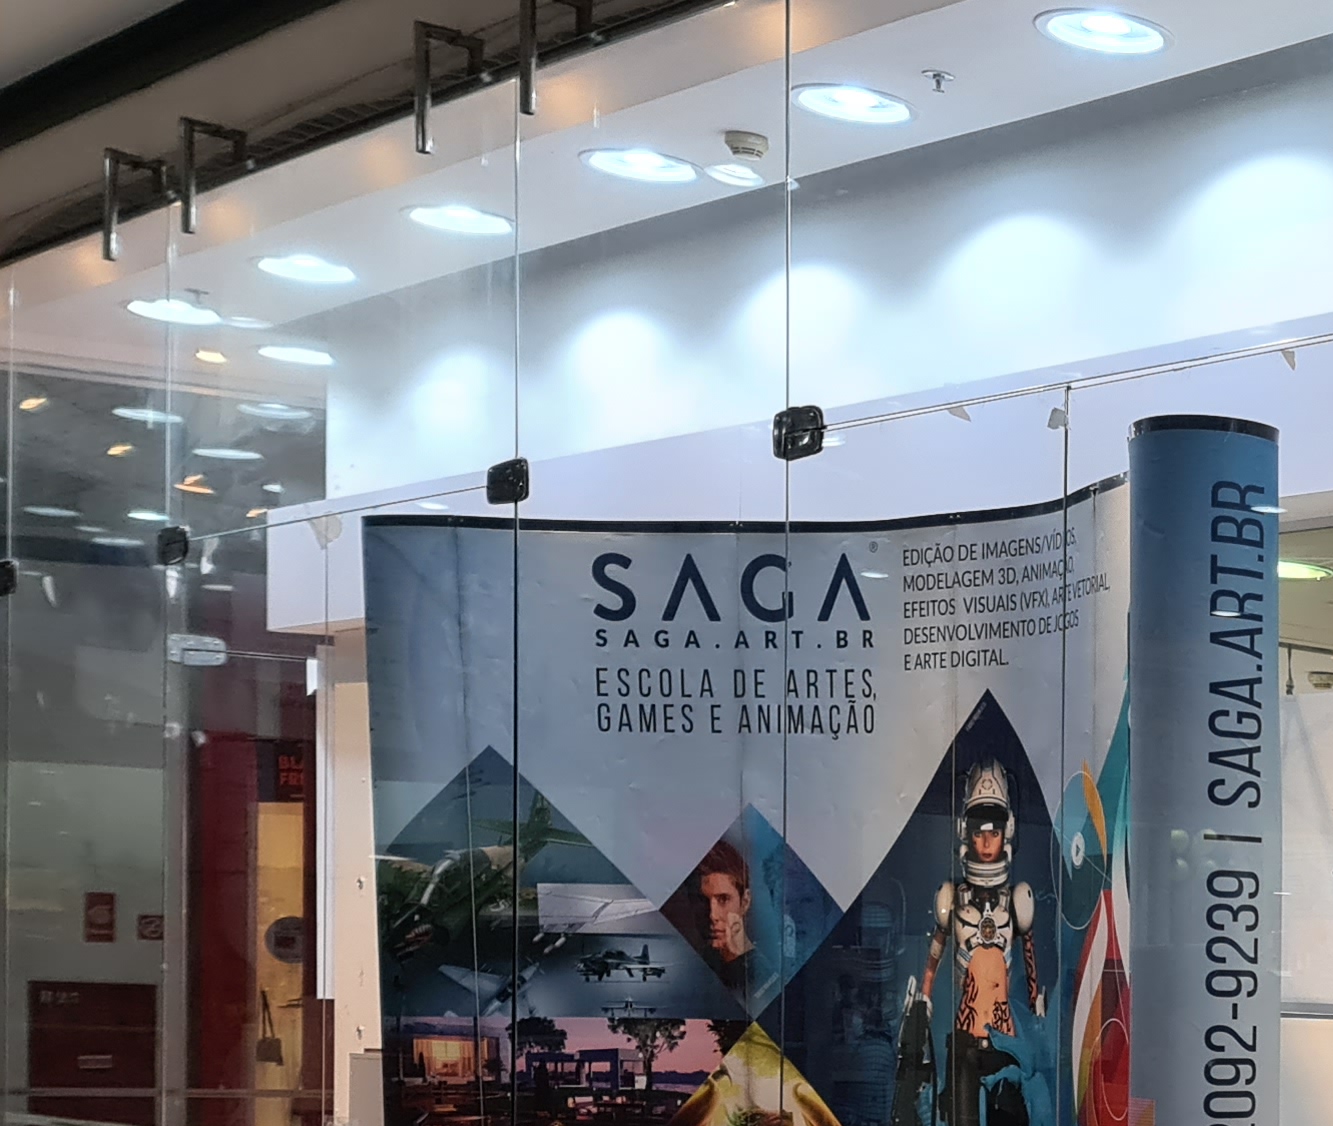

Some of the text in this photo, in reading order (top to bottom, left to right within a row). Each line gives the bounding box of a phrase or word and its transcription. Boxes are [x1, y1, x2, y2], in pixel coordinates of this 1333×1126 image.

[902, 543, 955, 567] EDIÇÃO
[958, 543, 978, 562] DE
[591, 552, 871, 623] SAGA
[902, 569, 994, 593] MODELAGEM
[998, 567, 1019, 587] 3D,
[903, 598, 956, 619] EFEITOS
[962, 593, 1017, 615] VISUAIS
[903, 618, 1036, 645] DESENVOLVIMENTO
[1038, 616, 1052, 635] DE
[1207, 478, 1266, 810] SAGA.ART.BR
[904, 648, 1009, 671] E ARTE DIGITAL.
[595, 667, 877, 701] ESCOLA DE ARTES,
[598, 700, 875, 740] GAMES E ANIMAÇÃO
